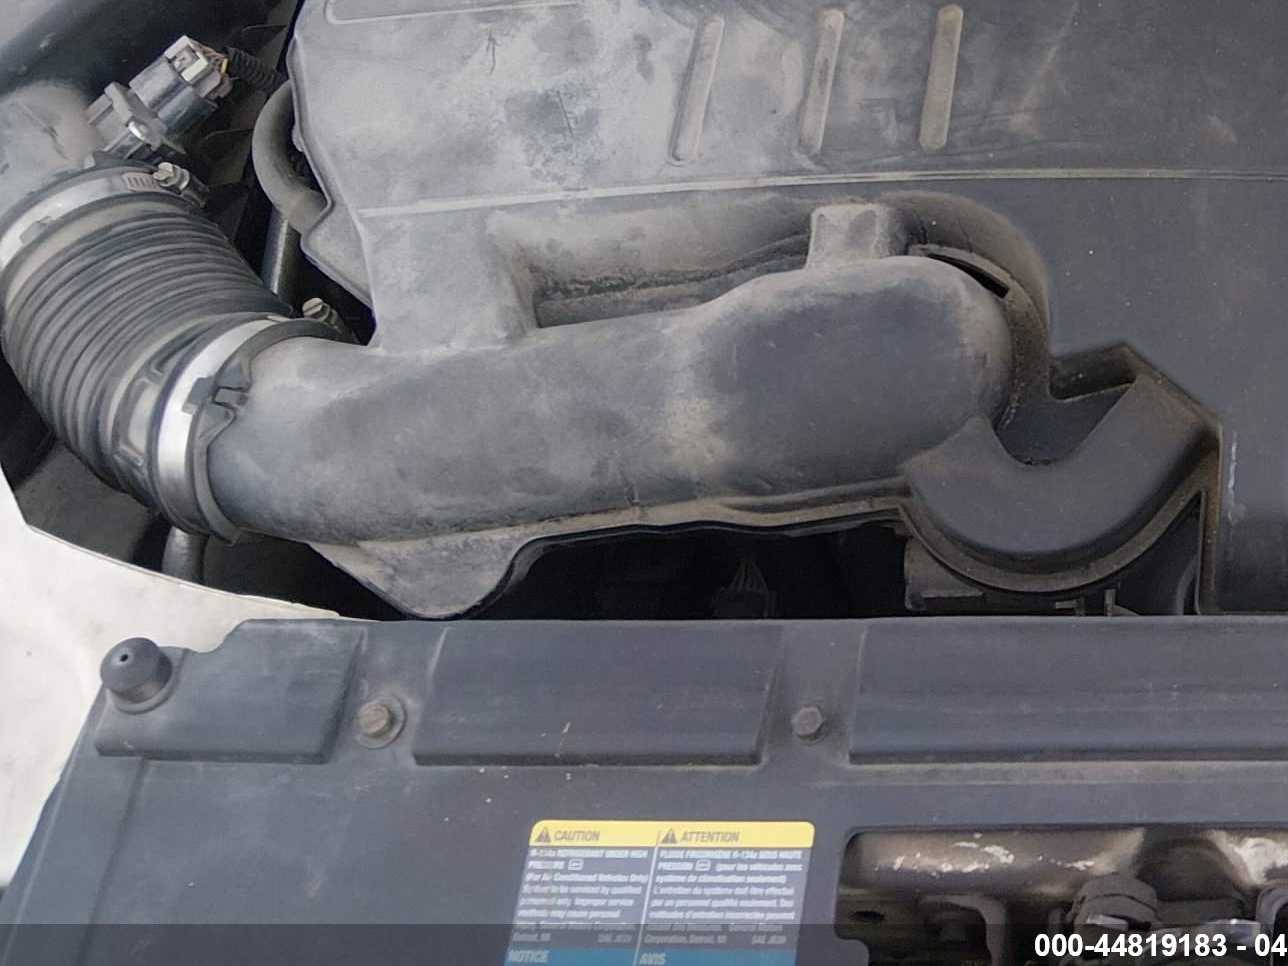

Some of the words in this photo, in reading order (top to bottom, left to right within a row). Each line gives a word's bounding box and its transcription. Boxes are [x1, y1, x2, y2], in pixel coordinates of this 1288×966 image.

[553, 830, 600, 842] CAUTION
[680, 831, 740, 843] ATTENTION
[508, 950, 549, 963] NOTICE
